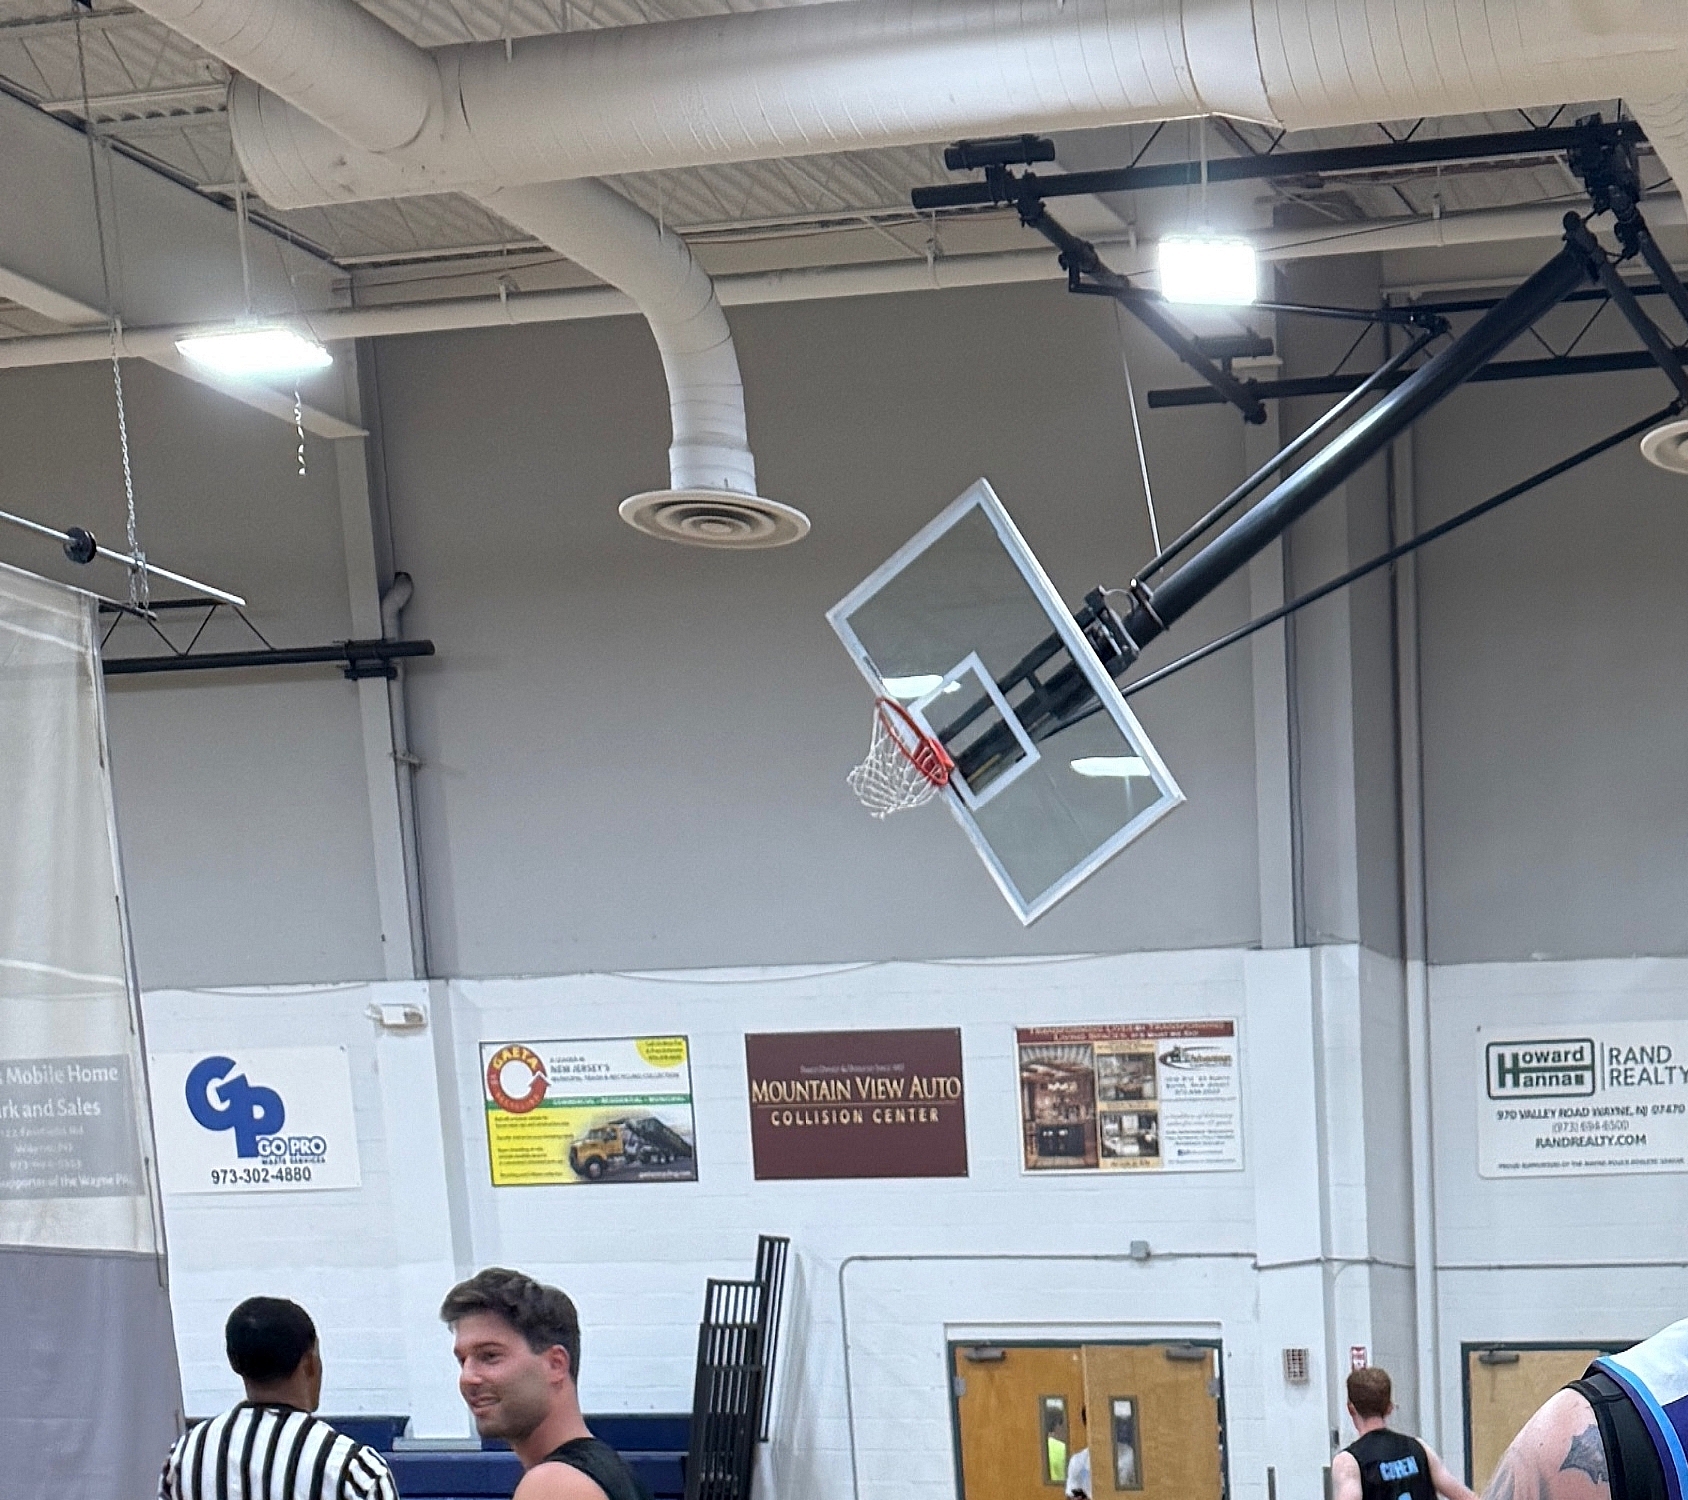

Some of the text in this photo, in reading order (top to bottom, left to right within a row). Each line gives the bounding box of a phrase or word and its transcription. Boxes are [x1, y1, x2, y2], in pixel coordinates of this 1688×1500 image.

[493, 1045, 539, 1070] GAETA
[1609, 1045, 1672, 1066] RAND
[6, 1064, 119, 1085] Mobile Home
[752, 1074, 962, 1103] MOUNTAIN VIEW AUTO
[22, 1098, 54, 1118] and
[57, 1096, 101, 1117] Sales
[771, 1107, 939, 1126] COLLISION CENTER
[1497, 1109, 1517, 1120] 970
[1519, 1108, 1558, 1120] VALLEY
[1558, 1107, 1590, 1118] ROAD
[1592, 1106, 1634, 1117] WAYNE,
[1635, 1105, 1649, 1117] NJ
[258, 1136, 327, 1157] GO PRO
[1535, 1133, 1648, 1149] RANDREALTY.COM
[211, 1165, 312, 1185] 973-302-4880
